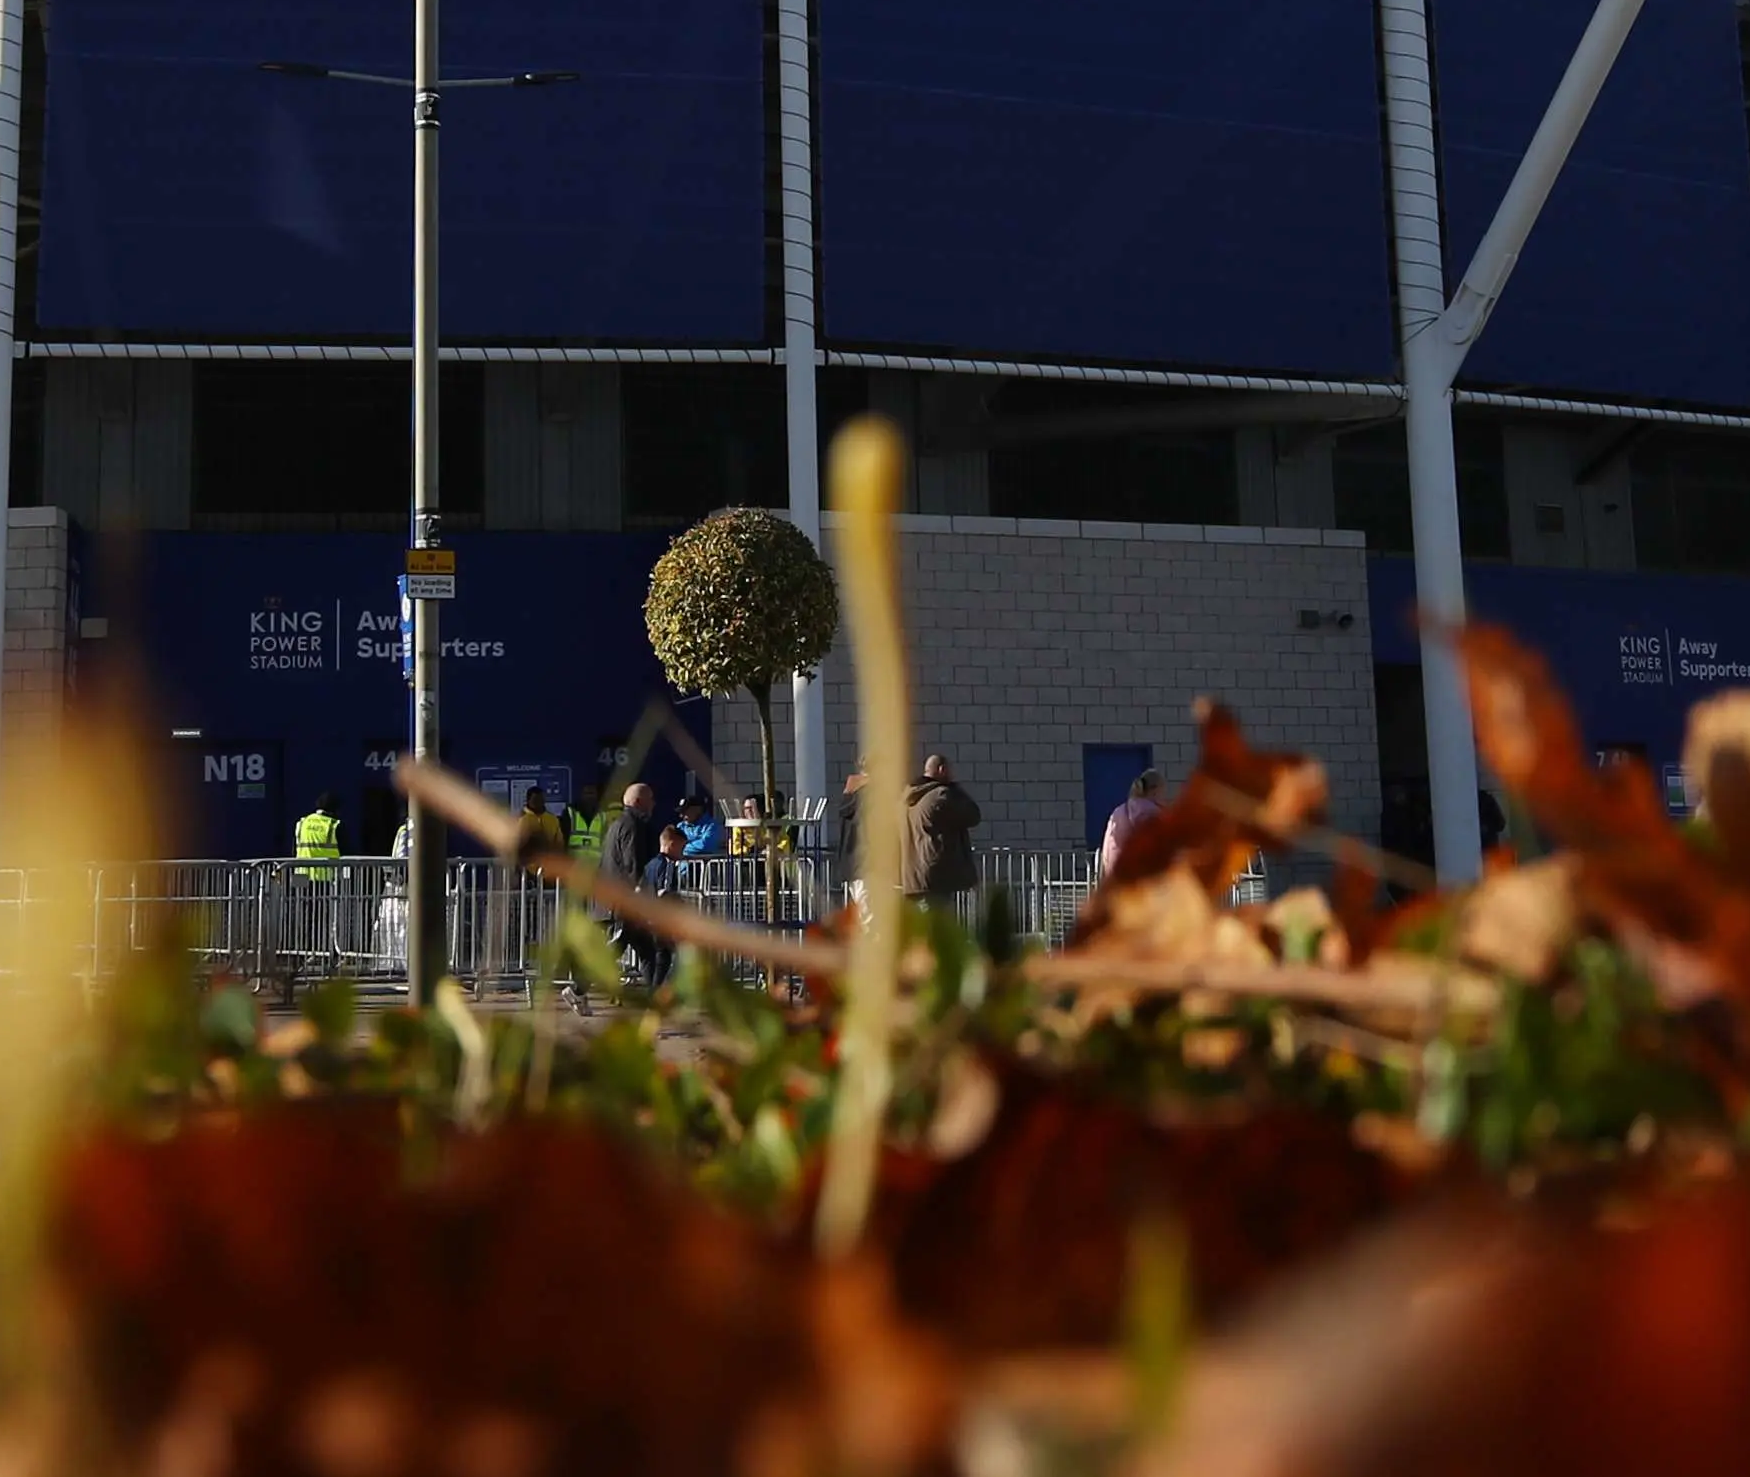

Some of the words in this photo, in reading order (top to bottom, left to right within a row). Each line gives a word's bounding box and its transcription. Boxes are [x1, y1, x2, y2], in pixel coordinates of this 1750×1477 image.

[250, 611, 323, 633] KING
[356, 611, 399, 631] Aw
[250, 635, 322, 652] POWER
[356, 637, 505, 663] Suprters
[1618, 635, 1662, 655] KING
[1678, 637, 1719, 660] Away
[250, 655, 323, 670] STADIUM
[1621, 655, 1663, 670] POWER
[1623, 671, 1664, 685] STADIUM
[597, 747, 630, 767] 46
[204, 753, 266, 783] N18
